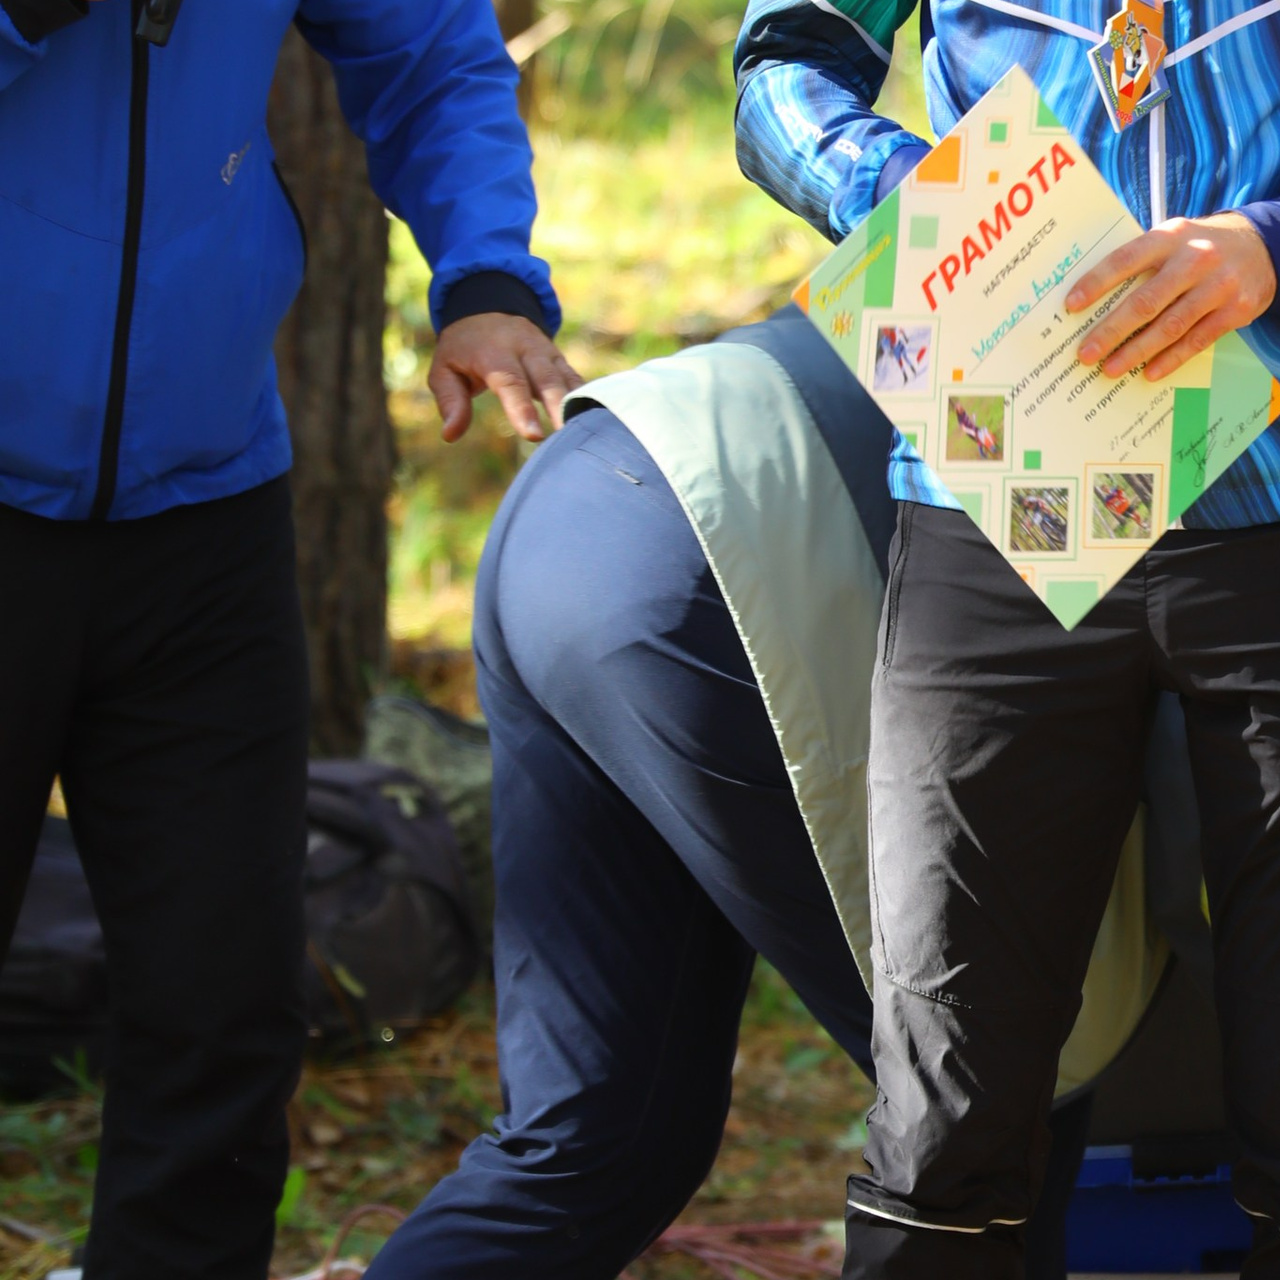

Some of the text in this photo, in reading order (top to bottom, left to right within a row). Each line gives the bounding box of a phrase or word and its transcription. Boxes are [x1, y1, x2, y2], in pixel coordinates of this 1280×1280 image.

[921, 142, 1076, 312] ГРАМОТА
[983, 218, 1057, 297] НАГРАЖДАЕТСЯ
[1010, 376, 1029, 401] XXVI
[1029, 317, 1095, 380] традиционных
[1040, 313, 1063, 340] за 1
[1024, 358, 1081, 417] по спортивно
[1084, 408, 1097, 422] по
[1096, 376, 1130, 409] группе:
